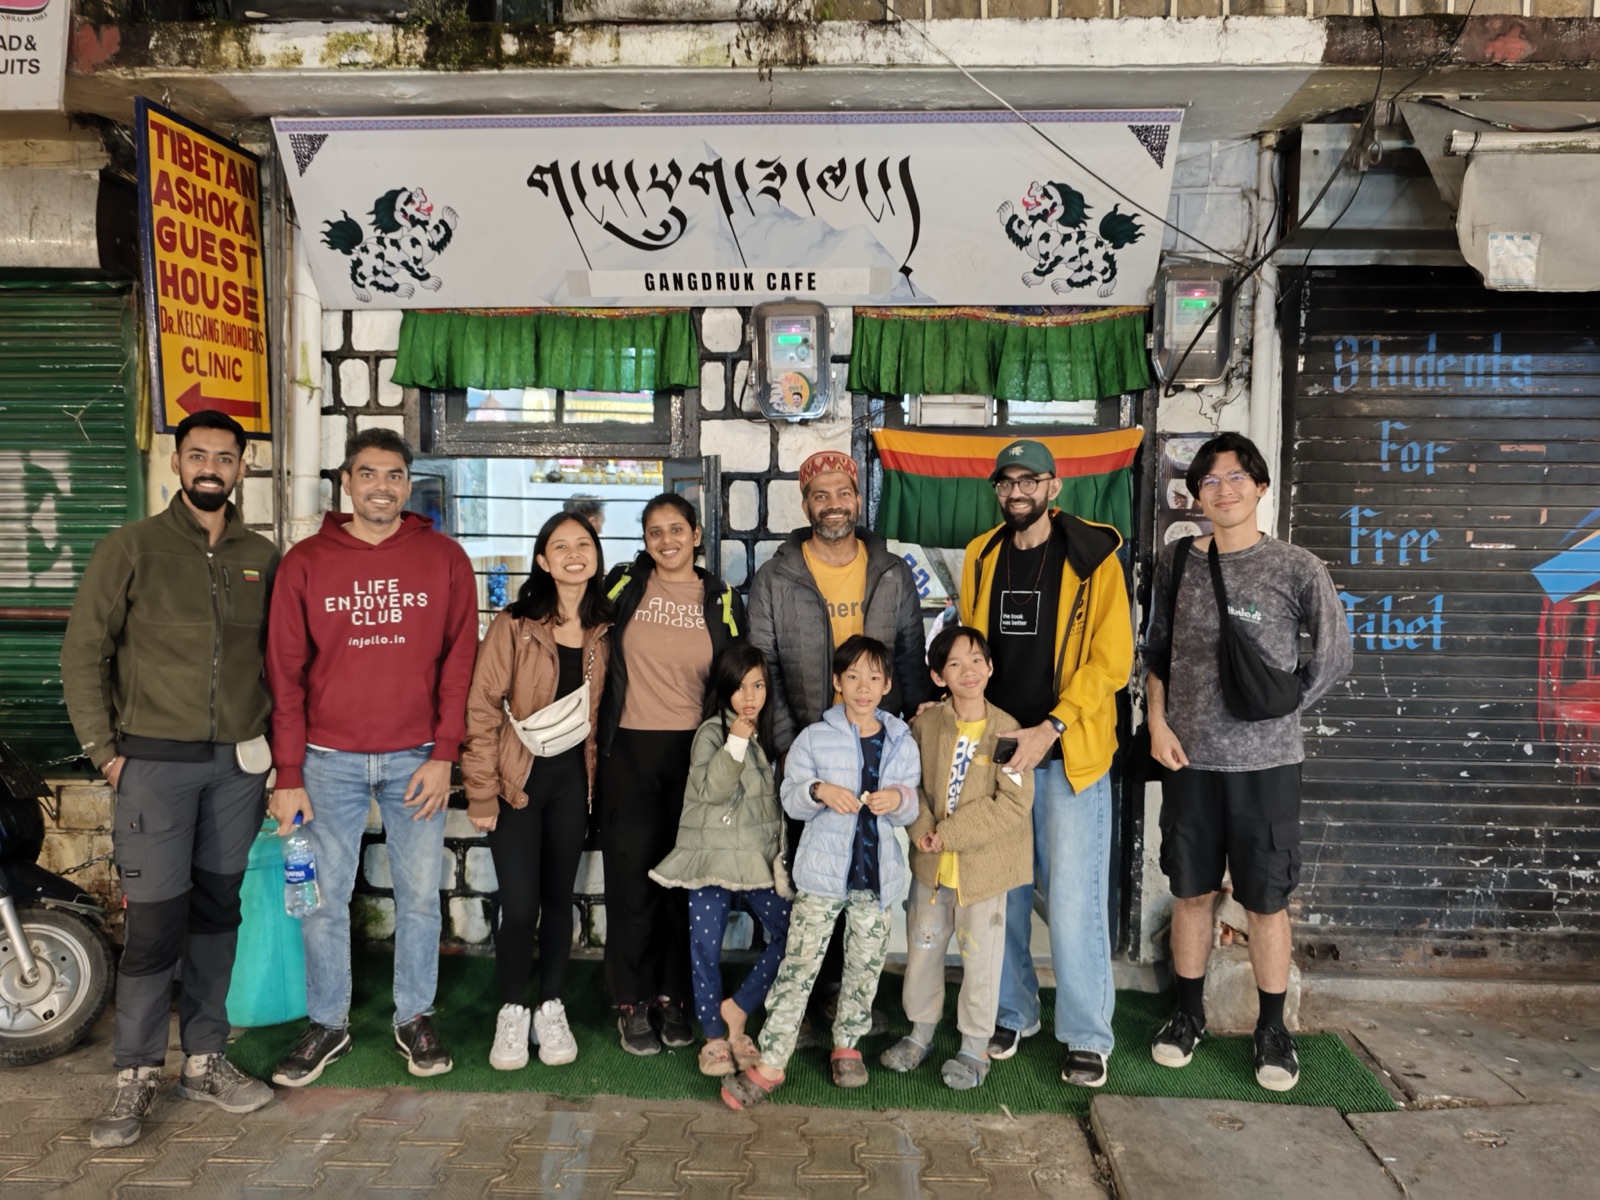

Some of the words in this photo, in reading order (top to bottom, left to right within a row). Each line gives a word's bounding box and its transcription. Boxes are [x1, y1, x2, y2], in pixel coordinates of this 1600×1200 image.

[149, 119, 256, 203] TIBETAN
[153, 168, 257, 242] ASHOKA
[156, 215, 258, 280] GUEST
[158, 258, 260, 323] HOUSE
[644, 272, 755, 291] GANGDRUK
[766, 272, 817, 291] CAFE
[181, 345, 243, 383] CLINIC
[1332, 331, 1534, 394] Students
[1372, 418, 1452, 476] For
[1339, 505, 1441, 566] Free
[324, 592, 429, 613] ENJOYERS
[353, 578, 400, 595] LIFE
[347, 634, 406, 649] injello.in
[351, 608, 403, 626] CLUB
